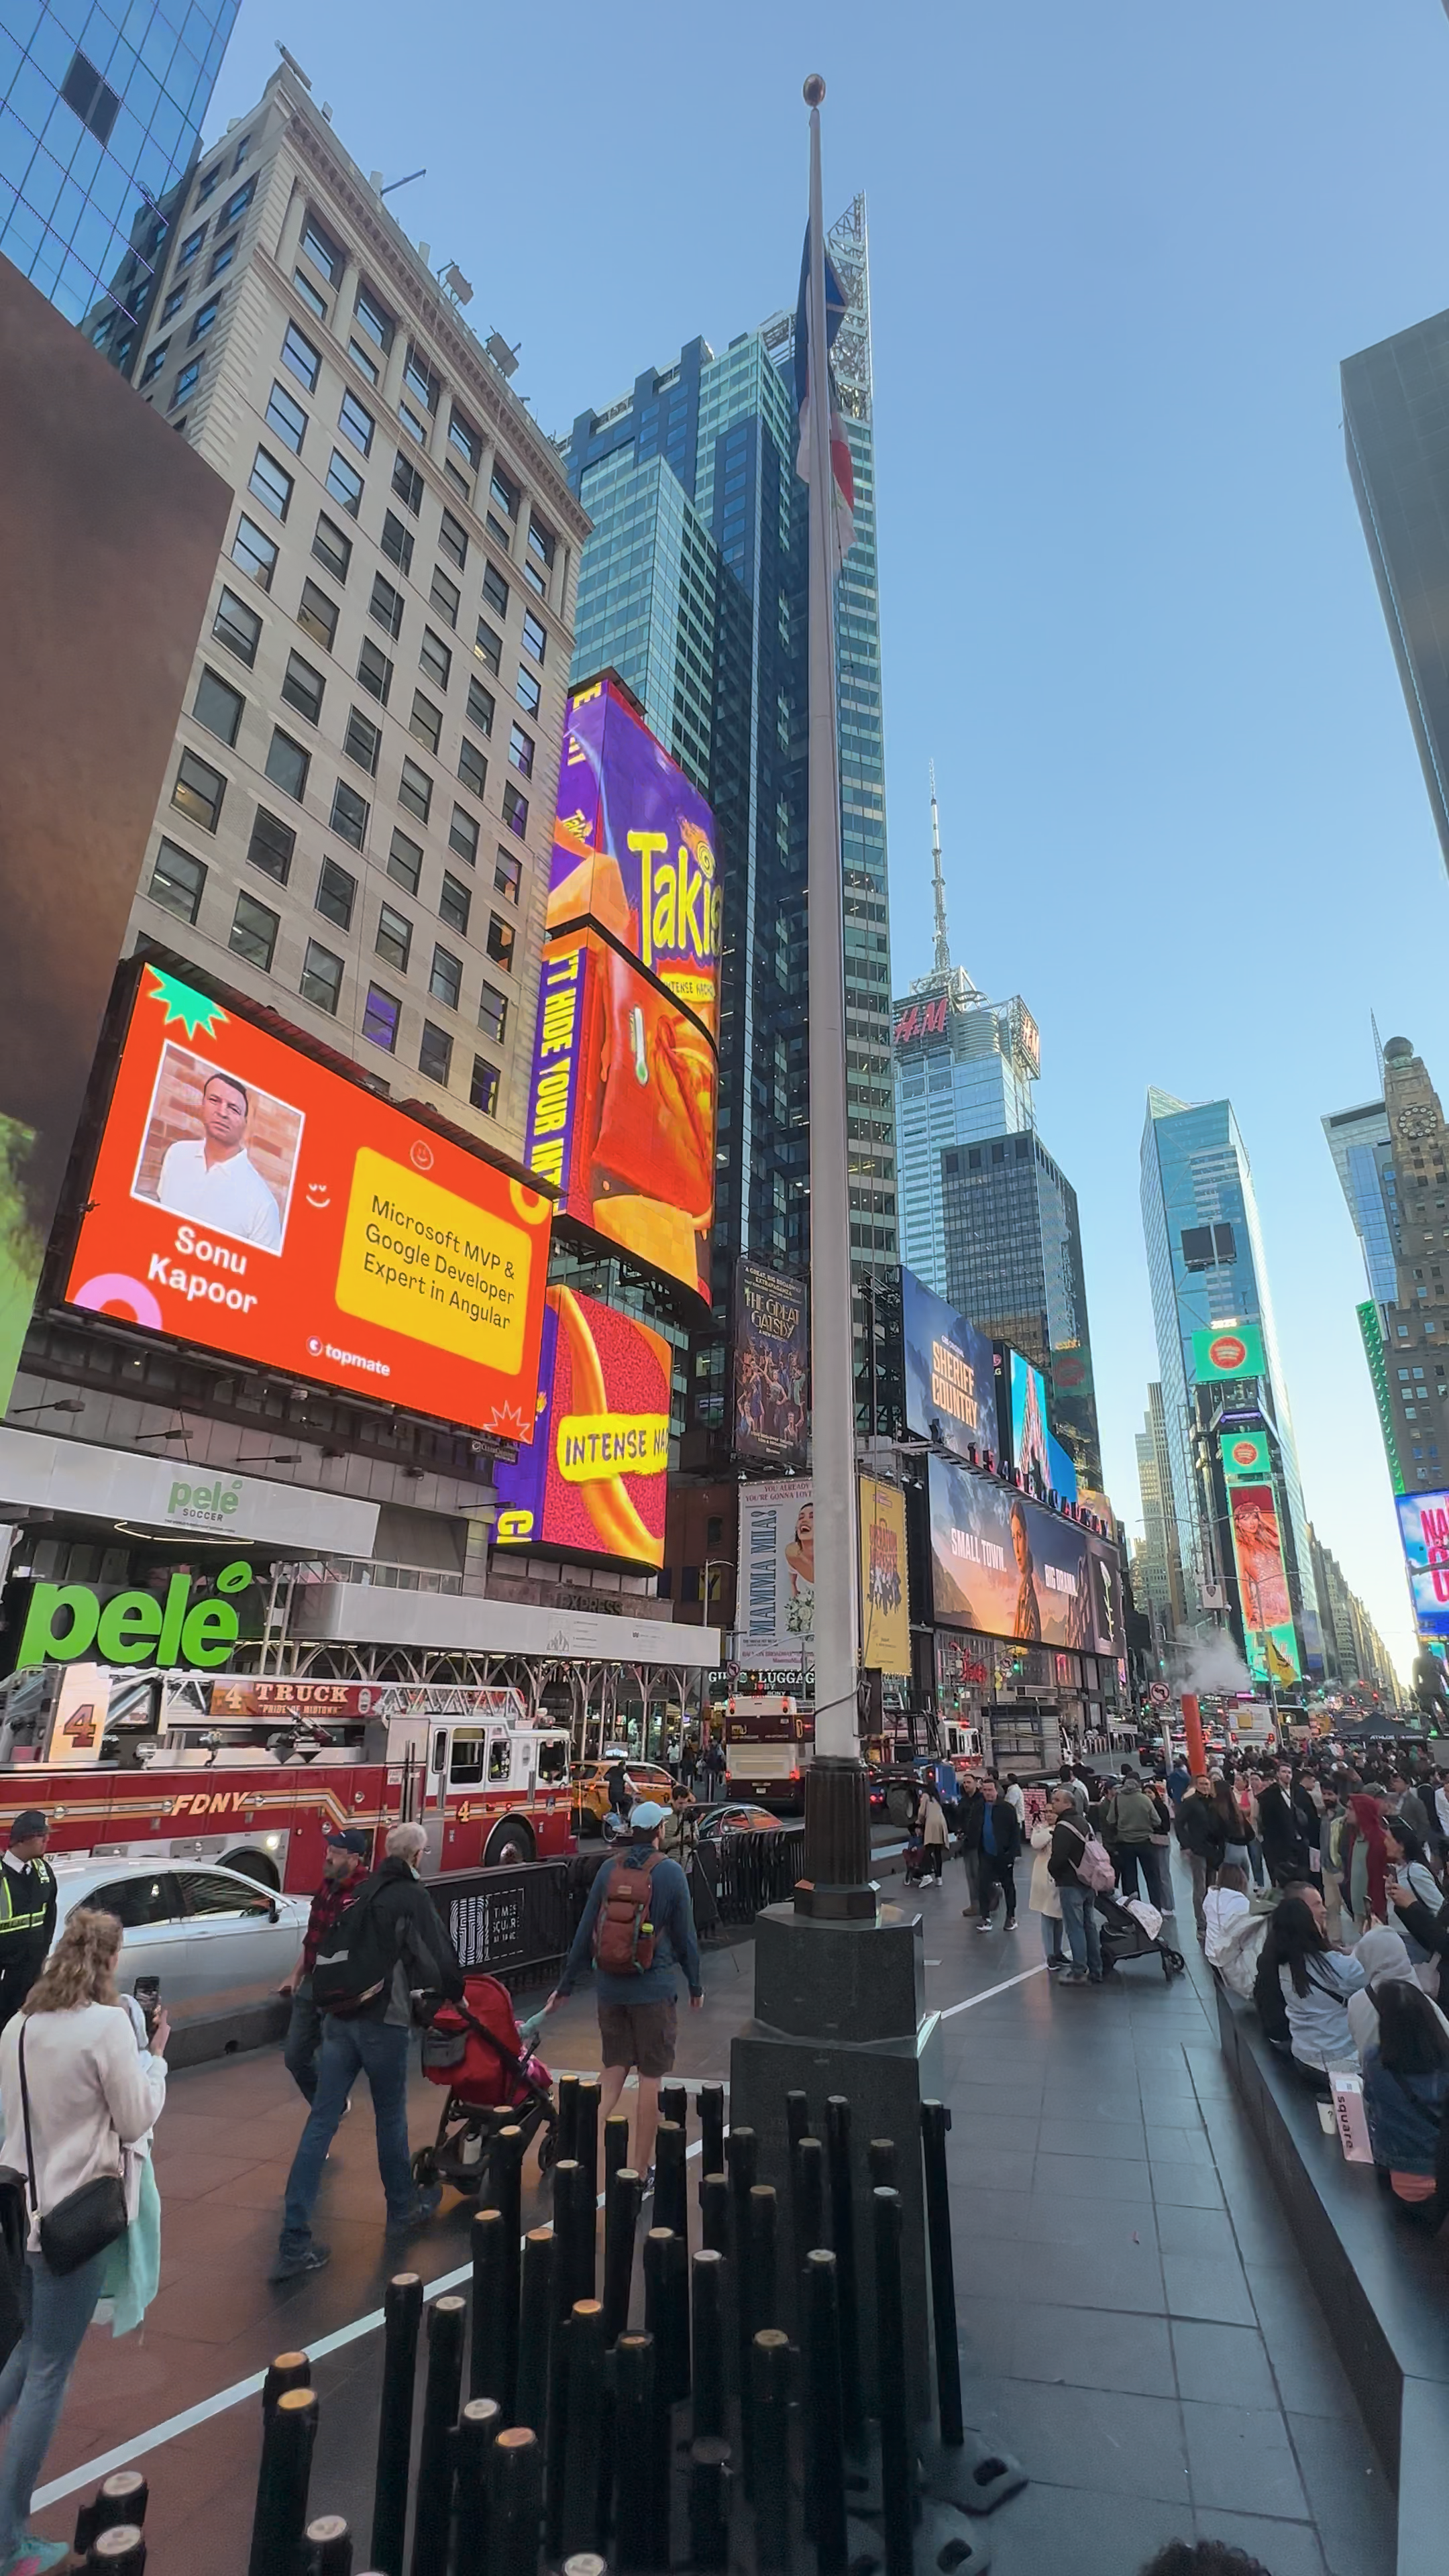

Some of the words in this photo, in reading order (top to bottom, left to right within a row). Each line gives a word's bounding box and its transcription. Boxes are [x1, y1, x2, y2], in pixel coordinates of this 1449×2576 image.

[541, 987, 576, 1057] HIDE
[894, 996, 948, 1043] H&M
[534, 1057, 571, 1136] YOUR
[174, 1226, 248, 1276] Sonu
[372, 1194, 461, 1253] Microsoft
[464, 1240, 501, 1270] MVP
[504, 1261, 515, 1280] &
[148, 1252, 258, 1314] Kapoor
[366, 1223, 430, 1267] Google
[435, 1254, 515, 1305] Developer
[364, 1252, 426, 1295] Expert
[431, 1280, 444, 1303] in
[449, 1291, 511, 1330] Angular
[745, 1289, 764, 1311] THE
[766, 1299, 800, 1325] GREAT
[751, 1310, 795, 1339] GATSBY
[325, 1343, 390, 1377] topmate
[933, 1341, 974, 1396] SHERIFF
[932, 1372, 977, 1429] COUNTRY
[565, 1429, 647, 1466] INTENSE
[167, 1480, 243, 1514] pelé
[745, 1493, 767, 1502] YOU'RE
[770, 1491, 794, 1500] GONNA
[765, 1484, 777, 1493] YOU
[780, 1483, 809, 1491] ALREADY
[182, 1508, 223, 1521] SOCCER
[751, 1510, 777, 1554] MIA!
[951, 1527, 981, 1563] SMALL
[981, 1538, 1007, 1572] TOWN.
[1044, 1564, 1055, 1589] BIG
[1056, 1568, 1078, 1597] DRAMA.
[17, 1561, 252, 1668] pelé
[559, 1594, 623, 1616] EXPRESS
[749, 1558, 776, 1636] MAMMA
[225, 1683, 241, 1709] 4
[256, 1684, 349, 1703] TRUCK
[64, 1704, 97, 1748] 4
[170, 1792, 252, 1817] FDNY
[458, 1801, 470, 1823] 4
[1338, 2096, 1353, 2149] square
